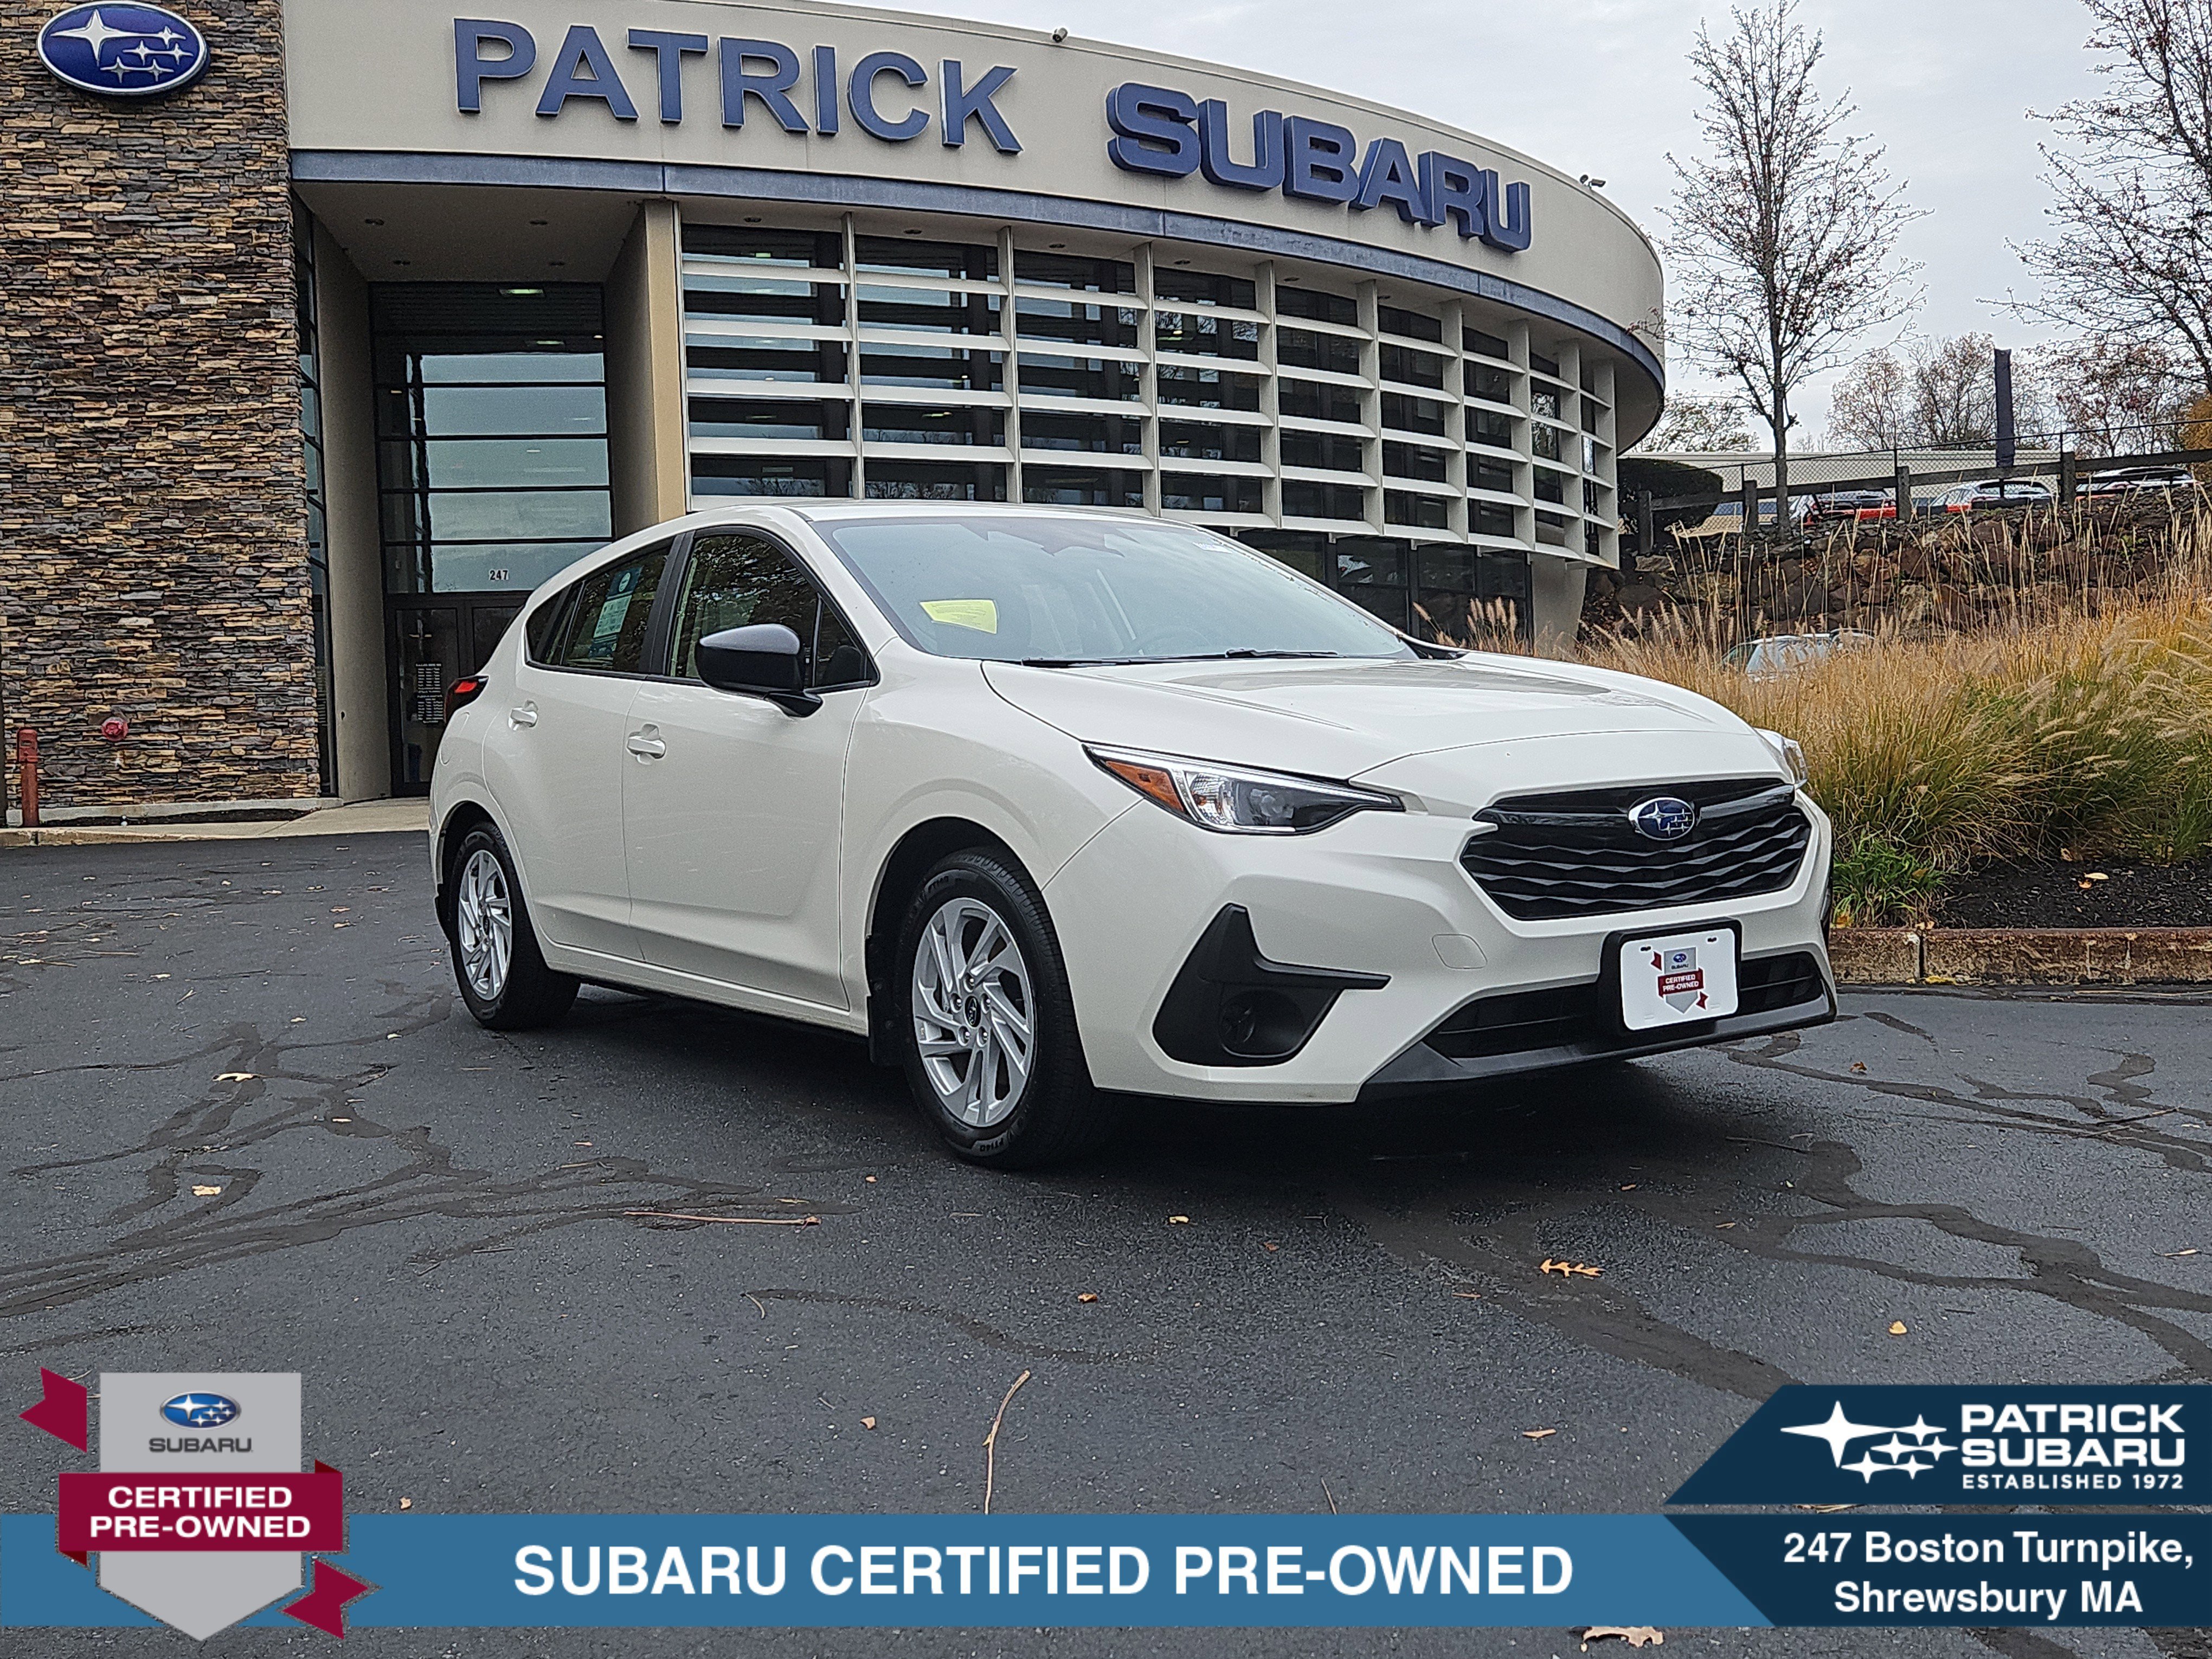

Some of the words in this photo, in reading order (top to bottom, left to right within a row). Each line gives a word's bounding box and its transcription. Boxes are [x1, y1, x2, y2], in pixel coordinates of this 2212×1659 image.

[453, 18, 1024, 153] PATRICK
[1106, 82, 1531, 253] SUBARU
[490, 570, 508, 580] 247
[1666, 974, 1696, 983] CERTIFIED
[1662, 981, 1699, 992] PRE-OWNED
